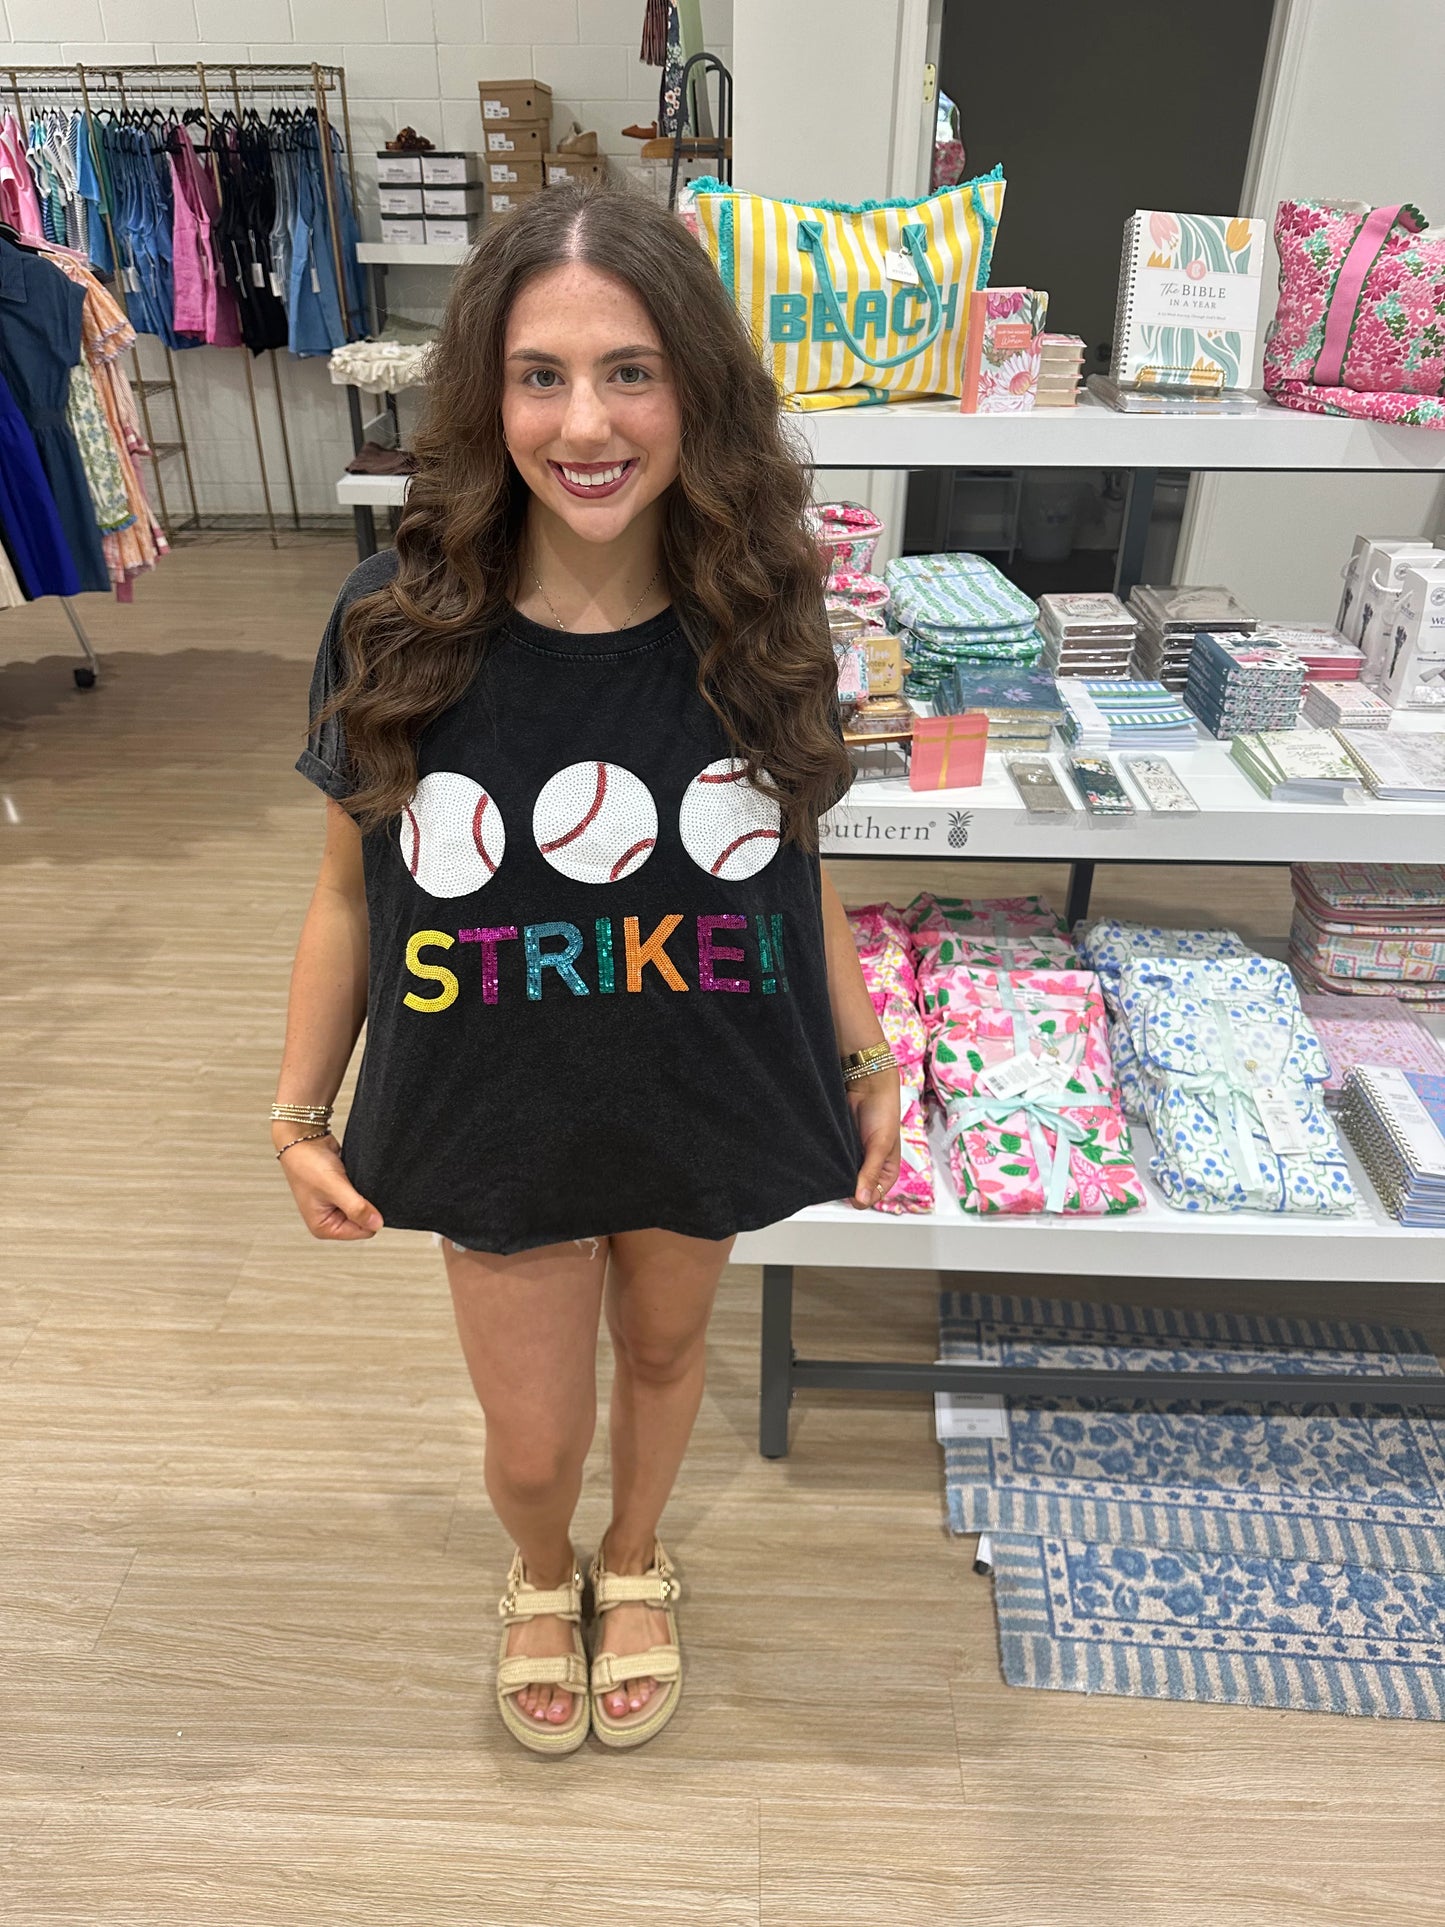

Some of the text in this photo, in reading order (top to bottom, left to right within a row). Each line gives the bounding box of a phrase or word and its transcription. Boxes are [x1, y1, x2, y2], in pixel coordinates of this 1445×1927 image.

[1160, 282, 1226, 299] The BIBLE
[1169, 298, 1180, 306] IN
[1192, 300, 1217, 309] YEAR
[770, 283, 959, 343] BEACH
[402, 913, 790, 1013] STRIKE!!
